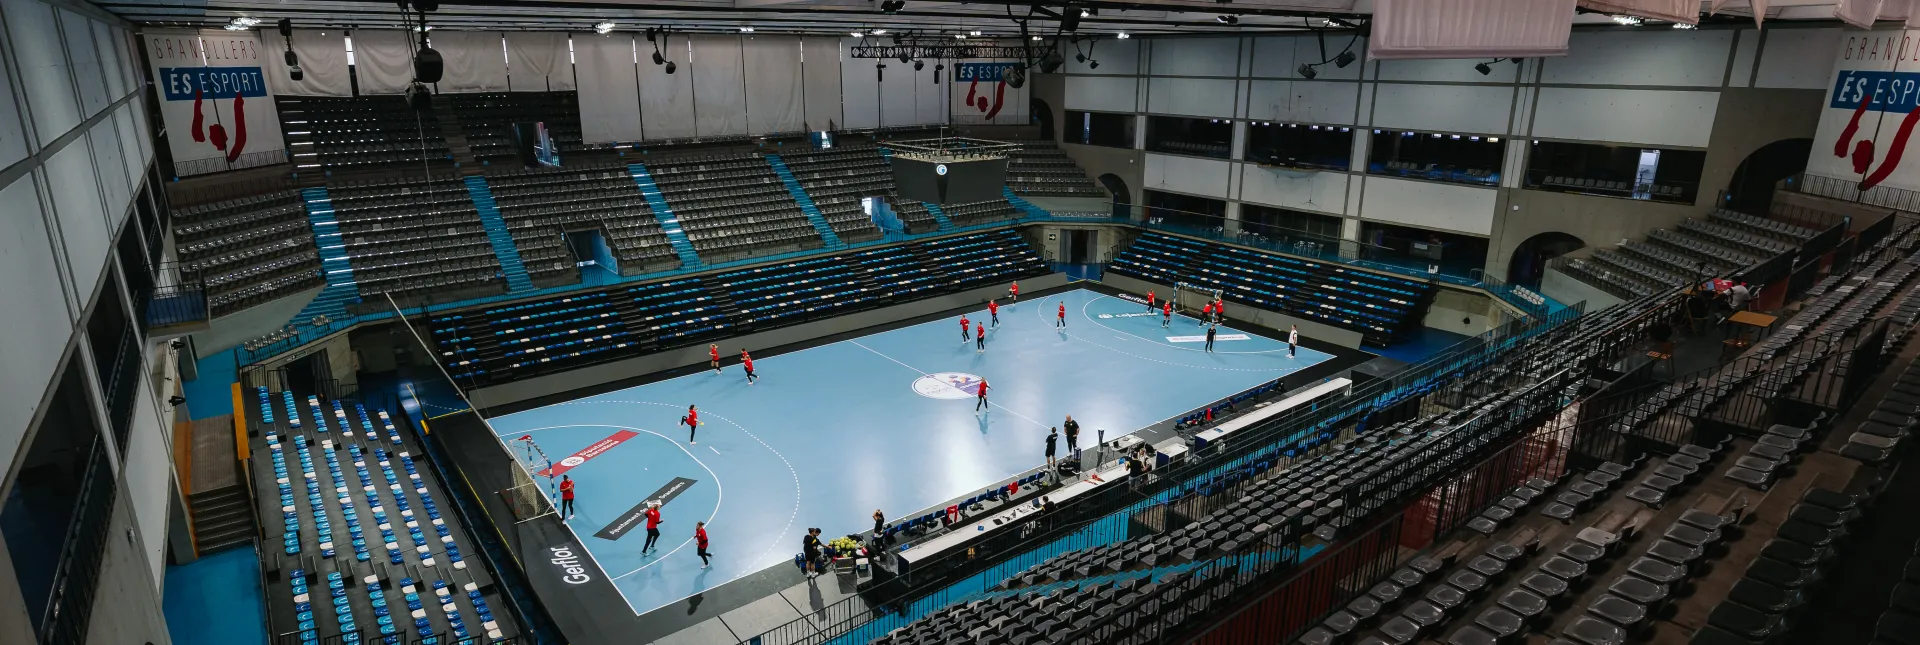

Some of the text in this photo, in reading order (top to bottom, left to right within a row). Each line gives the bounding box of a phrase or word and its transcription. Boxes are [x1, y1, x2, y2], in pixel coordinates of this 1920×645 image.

[153, 38, 257, 60] GRANOLLERS
[170, 68, 260, 95] ÉS ESPORT
[1838, 70, 1868, 103] ÉS
[550, 546, 590, 584] Gerflor
